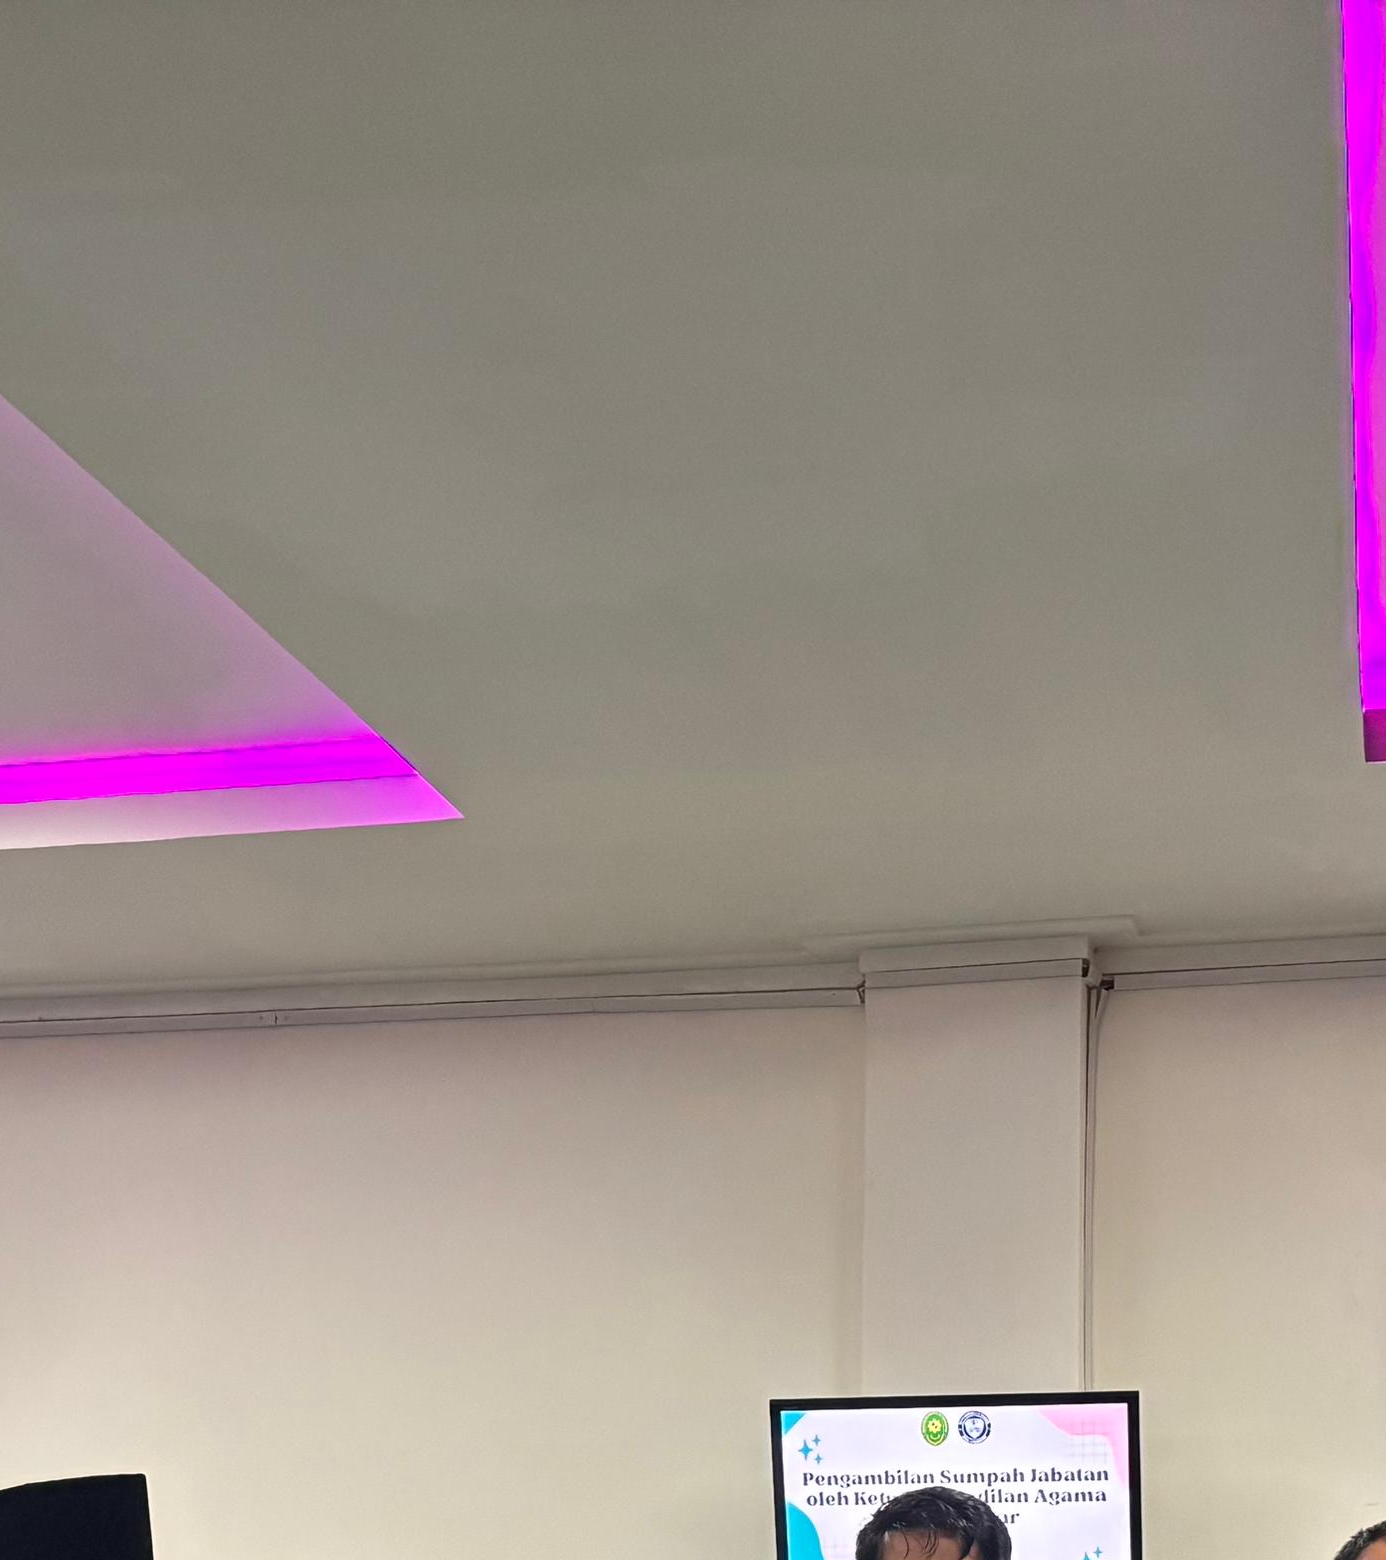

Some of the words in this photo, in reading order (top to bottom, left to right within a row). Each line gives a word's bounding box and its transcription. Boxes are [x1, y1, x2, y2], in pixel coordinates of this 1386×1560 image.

[802, 1469, 934, 1488] Pengambilan
[940, 1468, 1025, 1487] Sumpah
[1030, 1467, 1109, 1482] Jabatan
[806, 1491, 849, 1506] oleh
[1034, 1489, 1107, 1506] Agama
